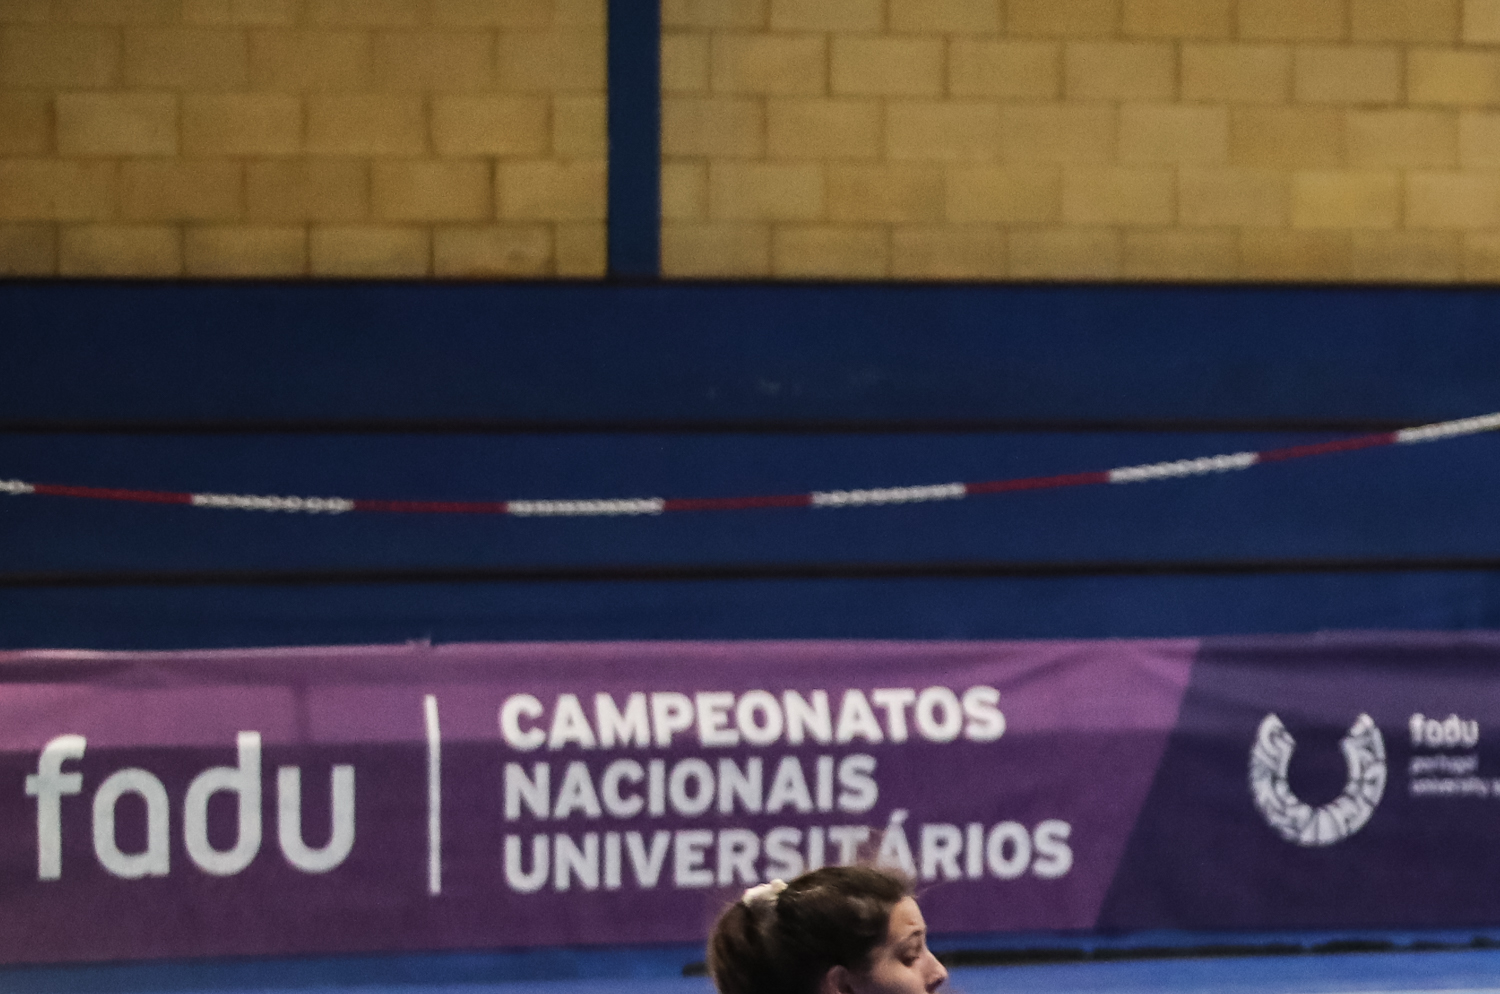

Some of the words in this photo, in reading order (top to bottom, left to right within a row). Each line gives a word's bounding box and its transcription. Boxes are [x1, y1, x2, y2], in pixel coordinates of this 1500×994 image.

[500, 685, 1006, 751] CAMPEONATOS
[25, 731, 356, 879] fadu
[504, 753, 879, 821] NACIONAIS
[504, 808, 1074, 893] UNIVERSITÁRIOS
